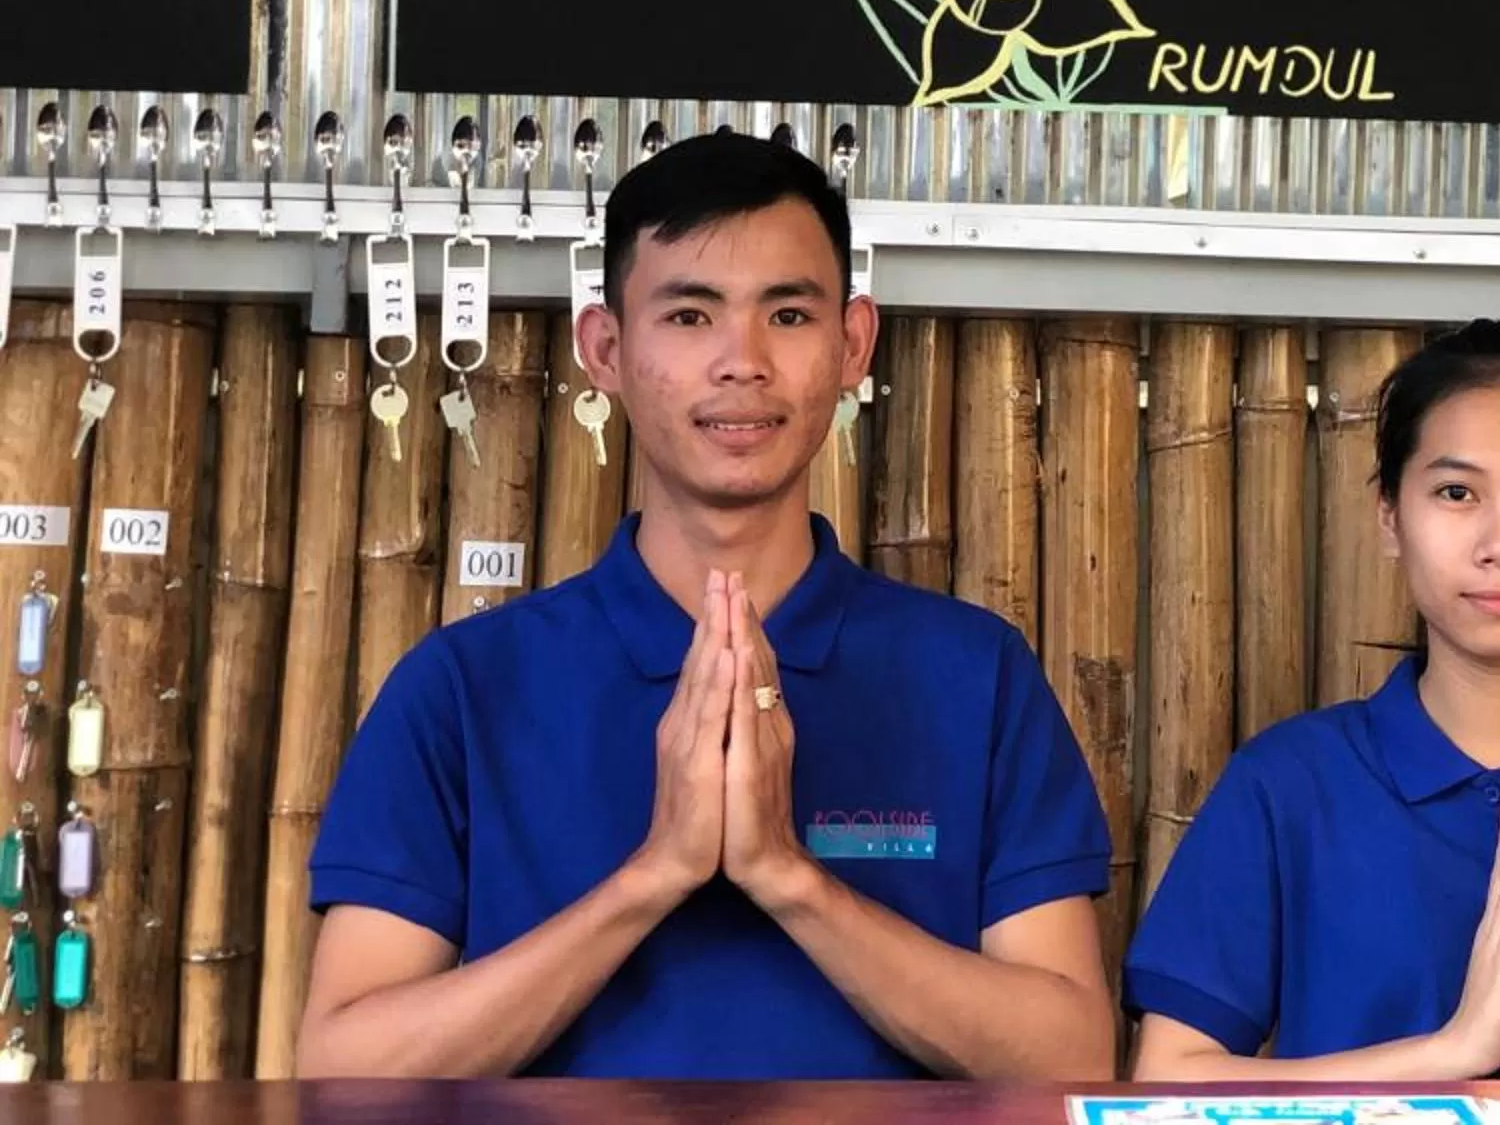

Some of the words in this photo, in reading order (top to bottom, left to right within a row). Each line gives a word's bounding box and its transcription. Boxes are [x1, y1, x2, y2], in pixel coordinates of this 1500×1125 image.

[1148, 43, 1394, 100] RUMDUL
[88, 270, 106, 315] 206
[385, 278, 402, 322] 212
[456, 282, 474, 325] 213
[0, 512, 47, 540] 003
[109, 517, 162, 546] 002
[468, 551, 515, 577] 001
